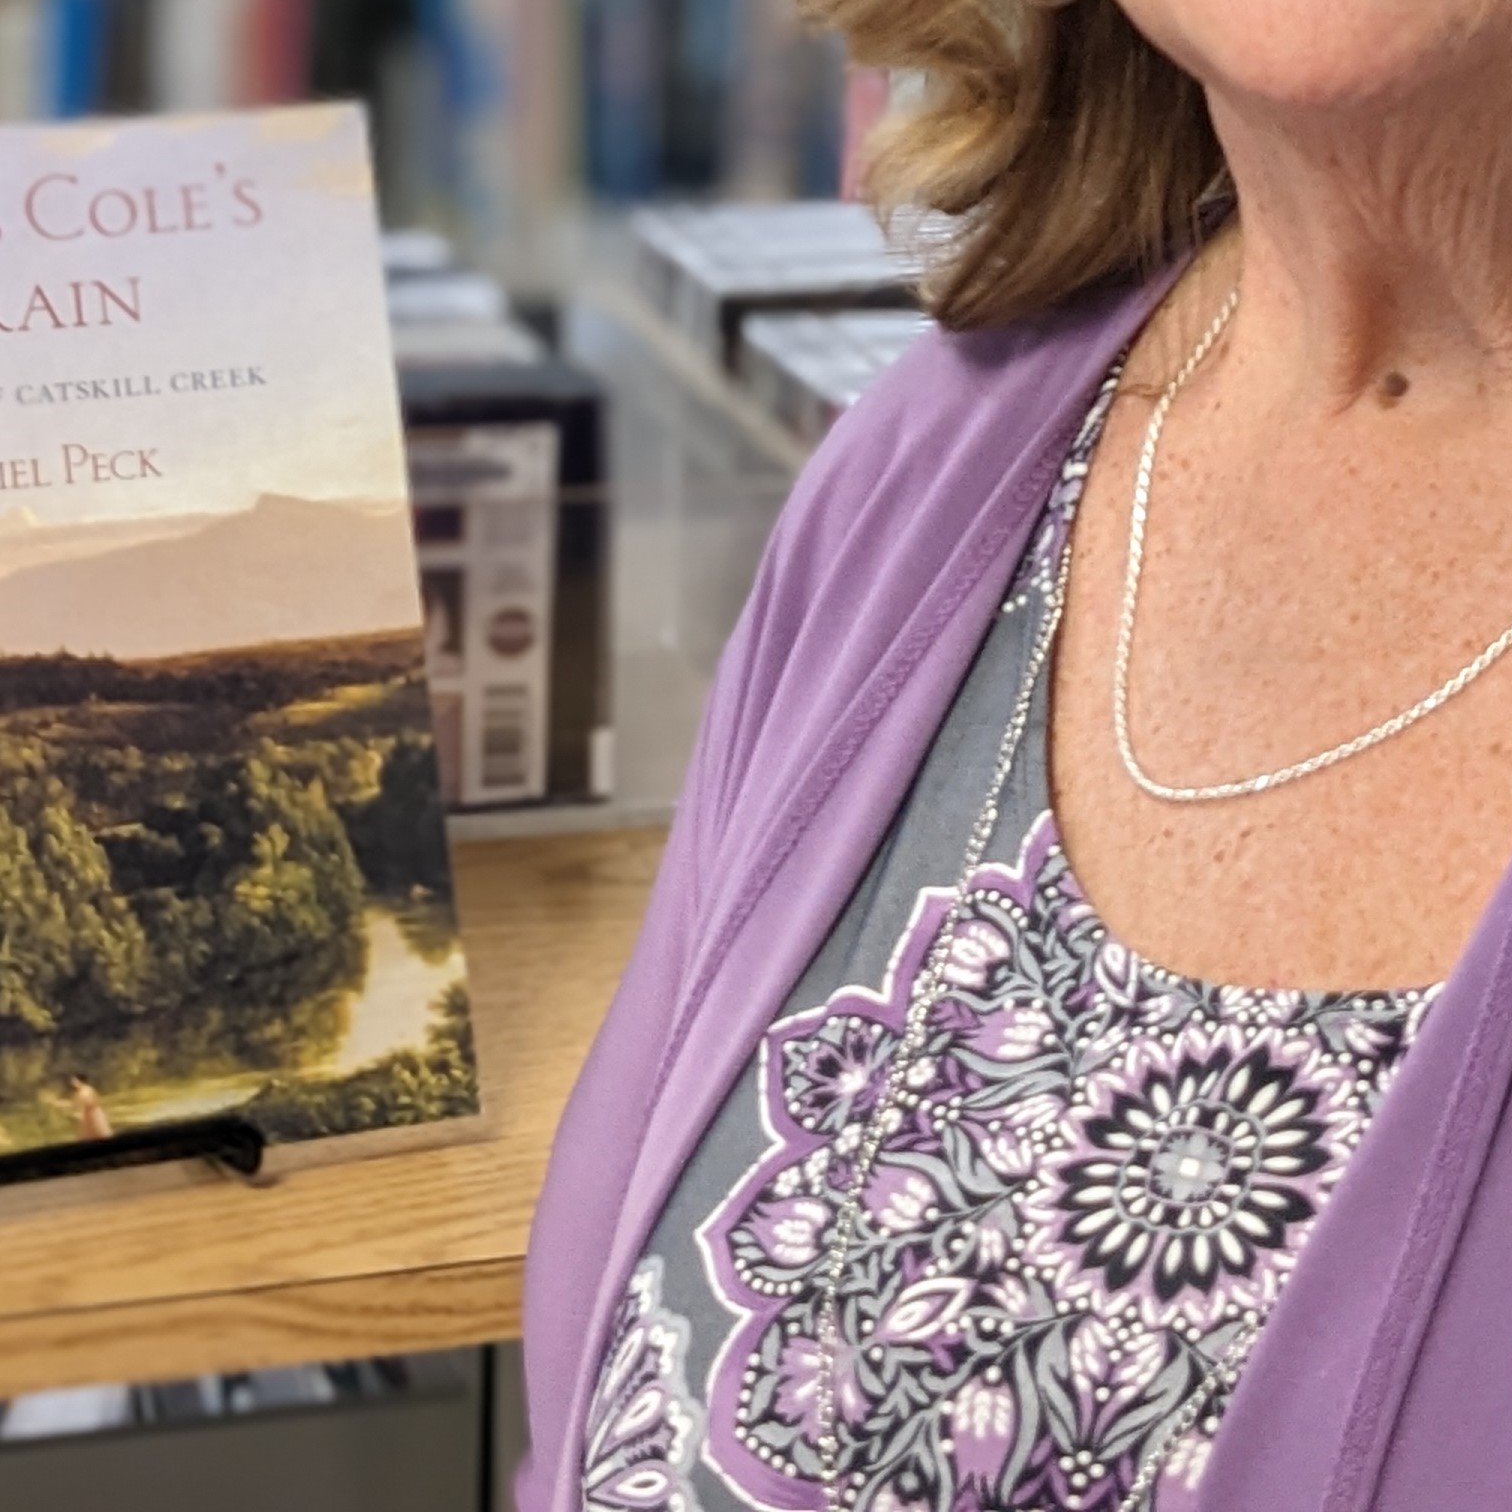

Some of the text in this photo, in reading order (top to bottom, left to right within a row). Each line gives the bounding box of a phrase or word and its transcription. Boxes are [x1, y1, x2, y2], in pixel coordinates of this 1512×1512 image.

[0, 276, 142, 332] AIN
[15, 366, 267, 405] CATSKILL CREEK
[61, 443, 164, 484] PECK
